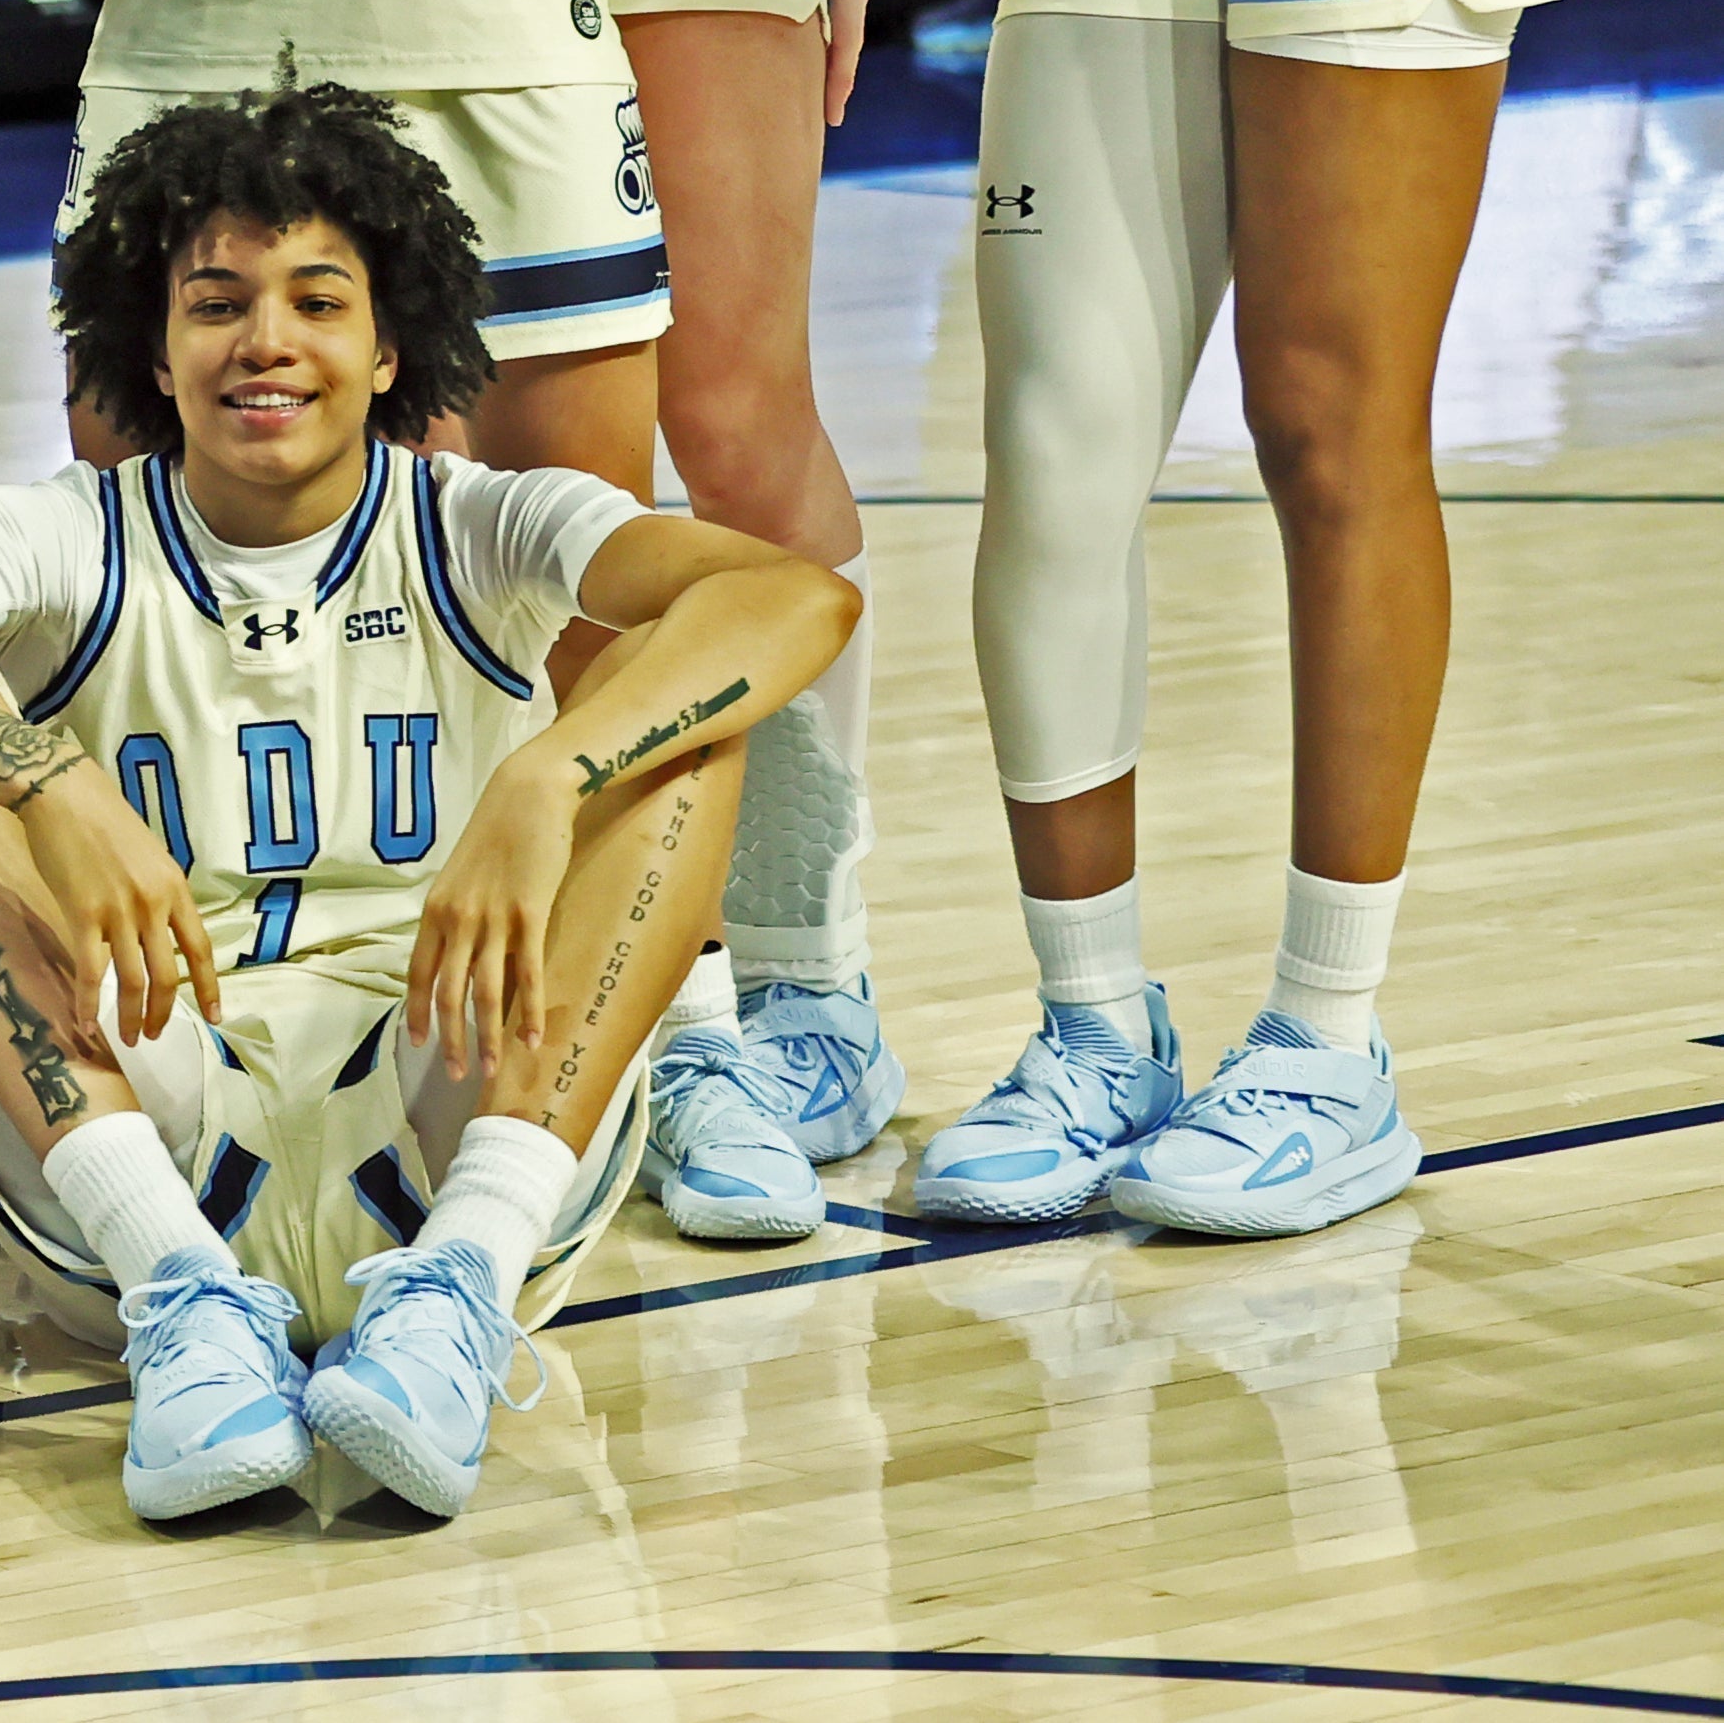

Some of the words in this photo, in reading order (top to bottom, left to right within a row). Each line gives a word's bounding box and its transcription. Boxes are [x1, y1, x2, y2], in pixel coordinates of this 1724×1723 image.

[344, 606, 407, 644] SBC
[116, 713, 440, 877] ODU
[661, 795, 693, 852] WHO
[238, 878, 303, 969] 1
[629, 869, 662, 923] GOD
[585, 940, 631, 1026] CHOSE
[554, 1042, 587, 1094] YOU
